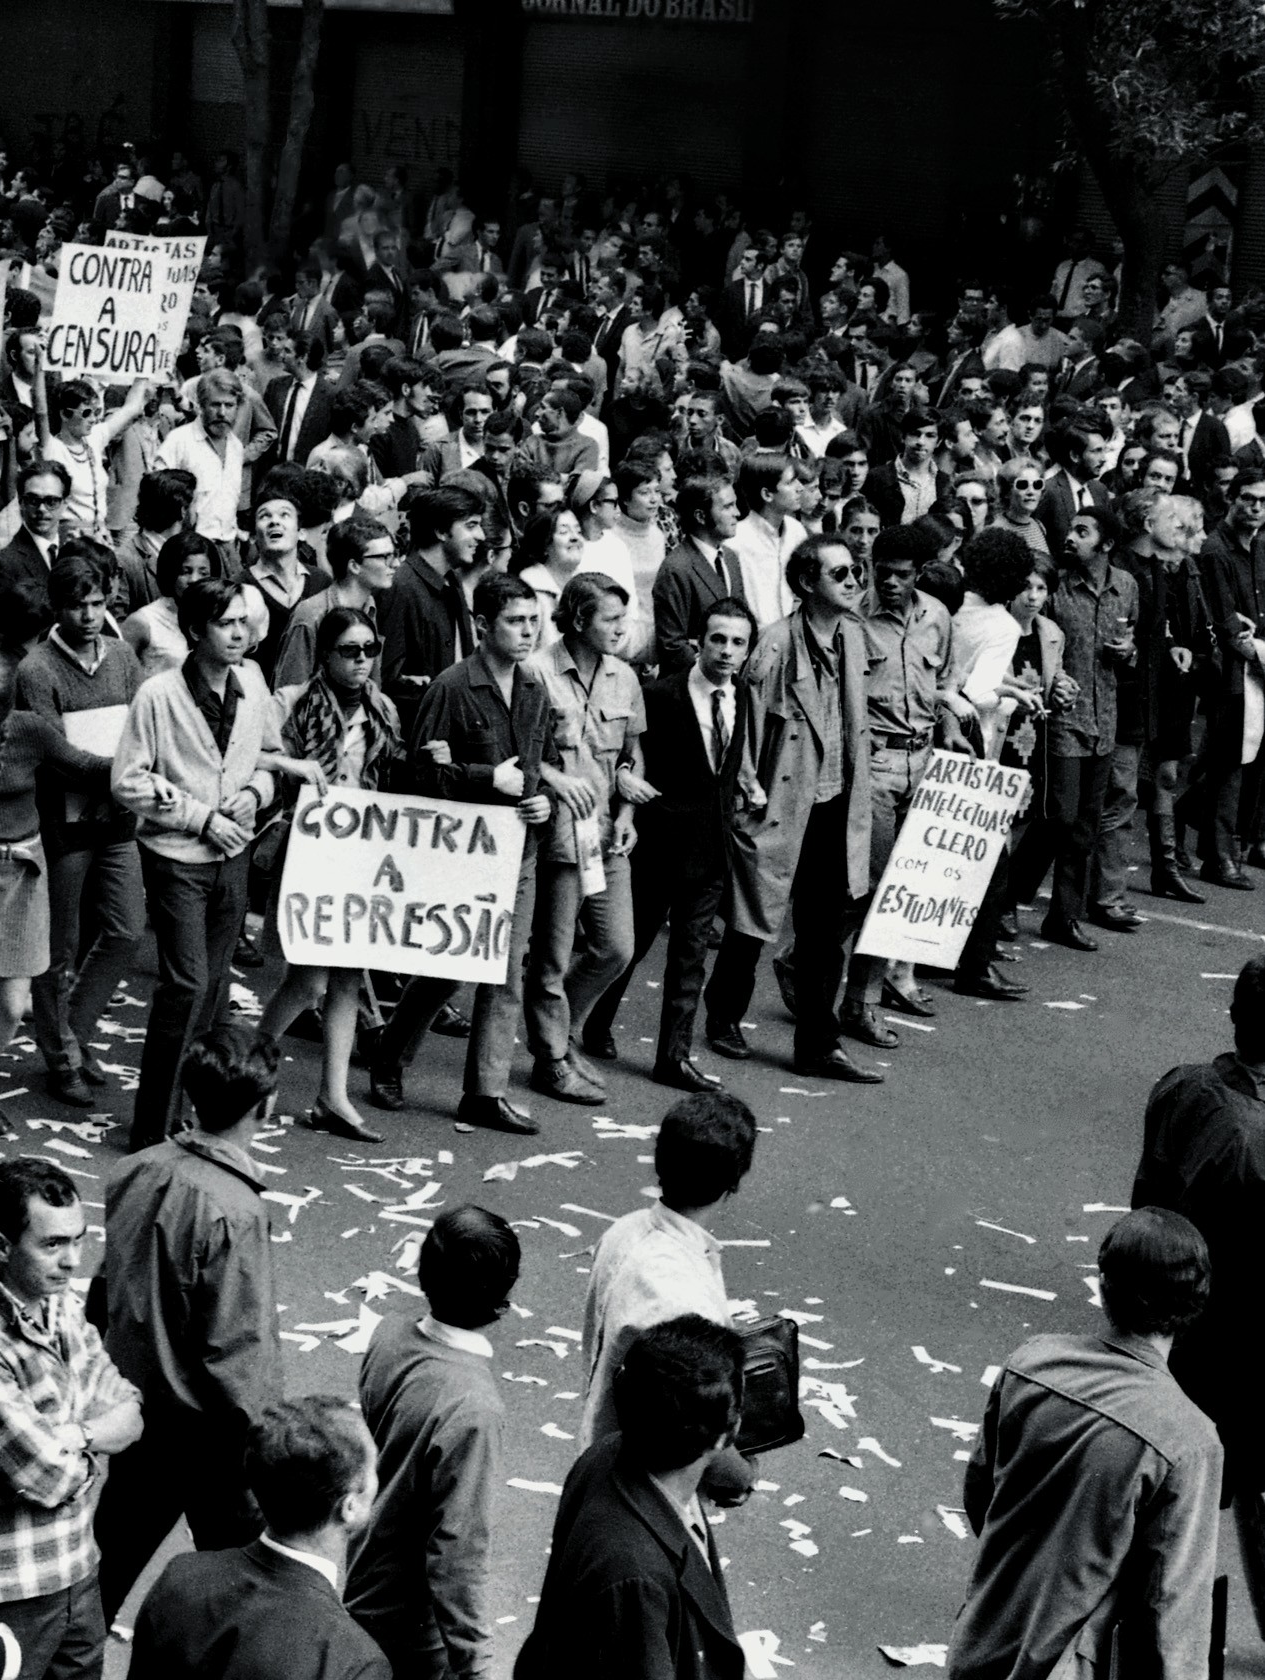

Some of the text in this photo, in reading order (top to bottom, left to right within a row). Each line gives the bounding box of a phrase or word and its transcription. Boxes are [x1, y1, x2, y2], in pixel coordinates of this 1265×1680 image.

[625, 0, 660, 17] DO
[106, 237, 198, 260] ARTTAS
[69, 251, 153, 294] CONTRA
[98, 296, 116, 325] A
[46, 324, 157, 374] CENSURA
[924, 757, 1022, 799] ARTISTAS
[297, 800, 497, 855] CONTRA
[912, 787, 1015, 836] INTELECTUAIS
[923, 826, 988, 862] CLERO
[373, 853, 405, 893] A
[895, 856, 962, 881] COM OS
[285, 892, 513, 961] REPRESSÃO
[876, 884, 979, 928] ESTUDANTES
